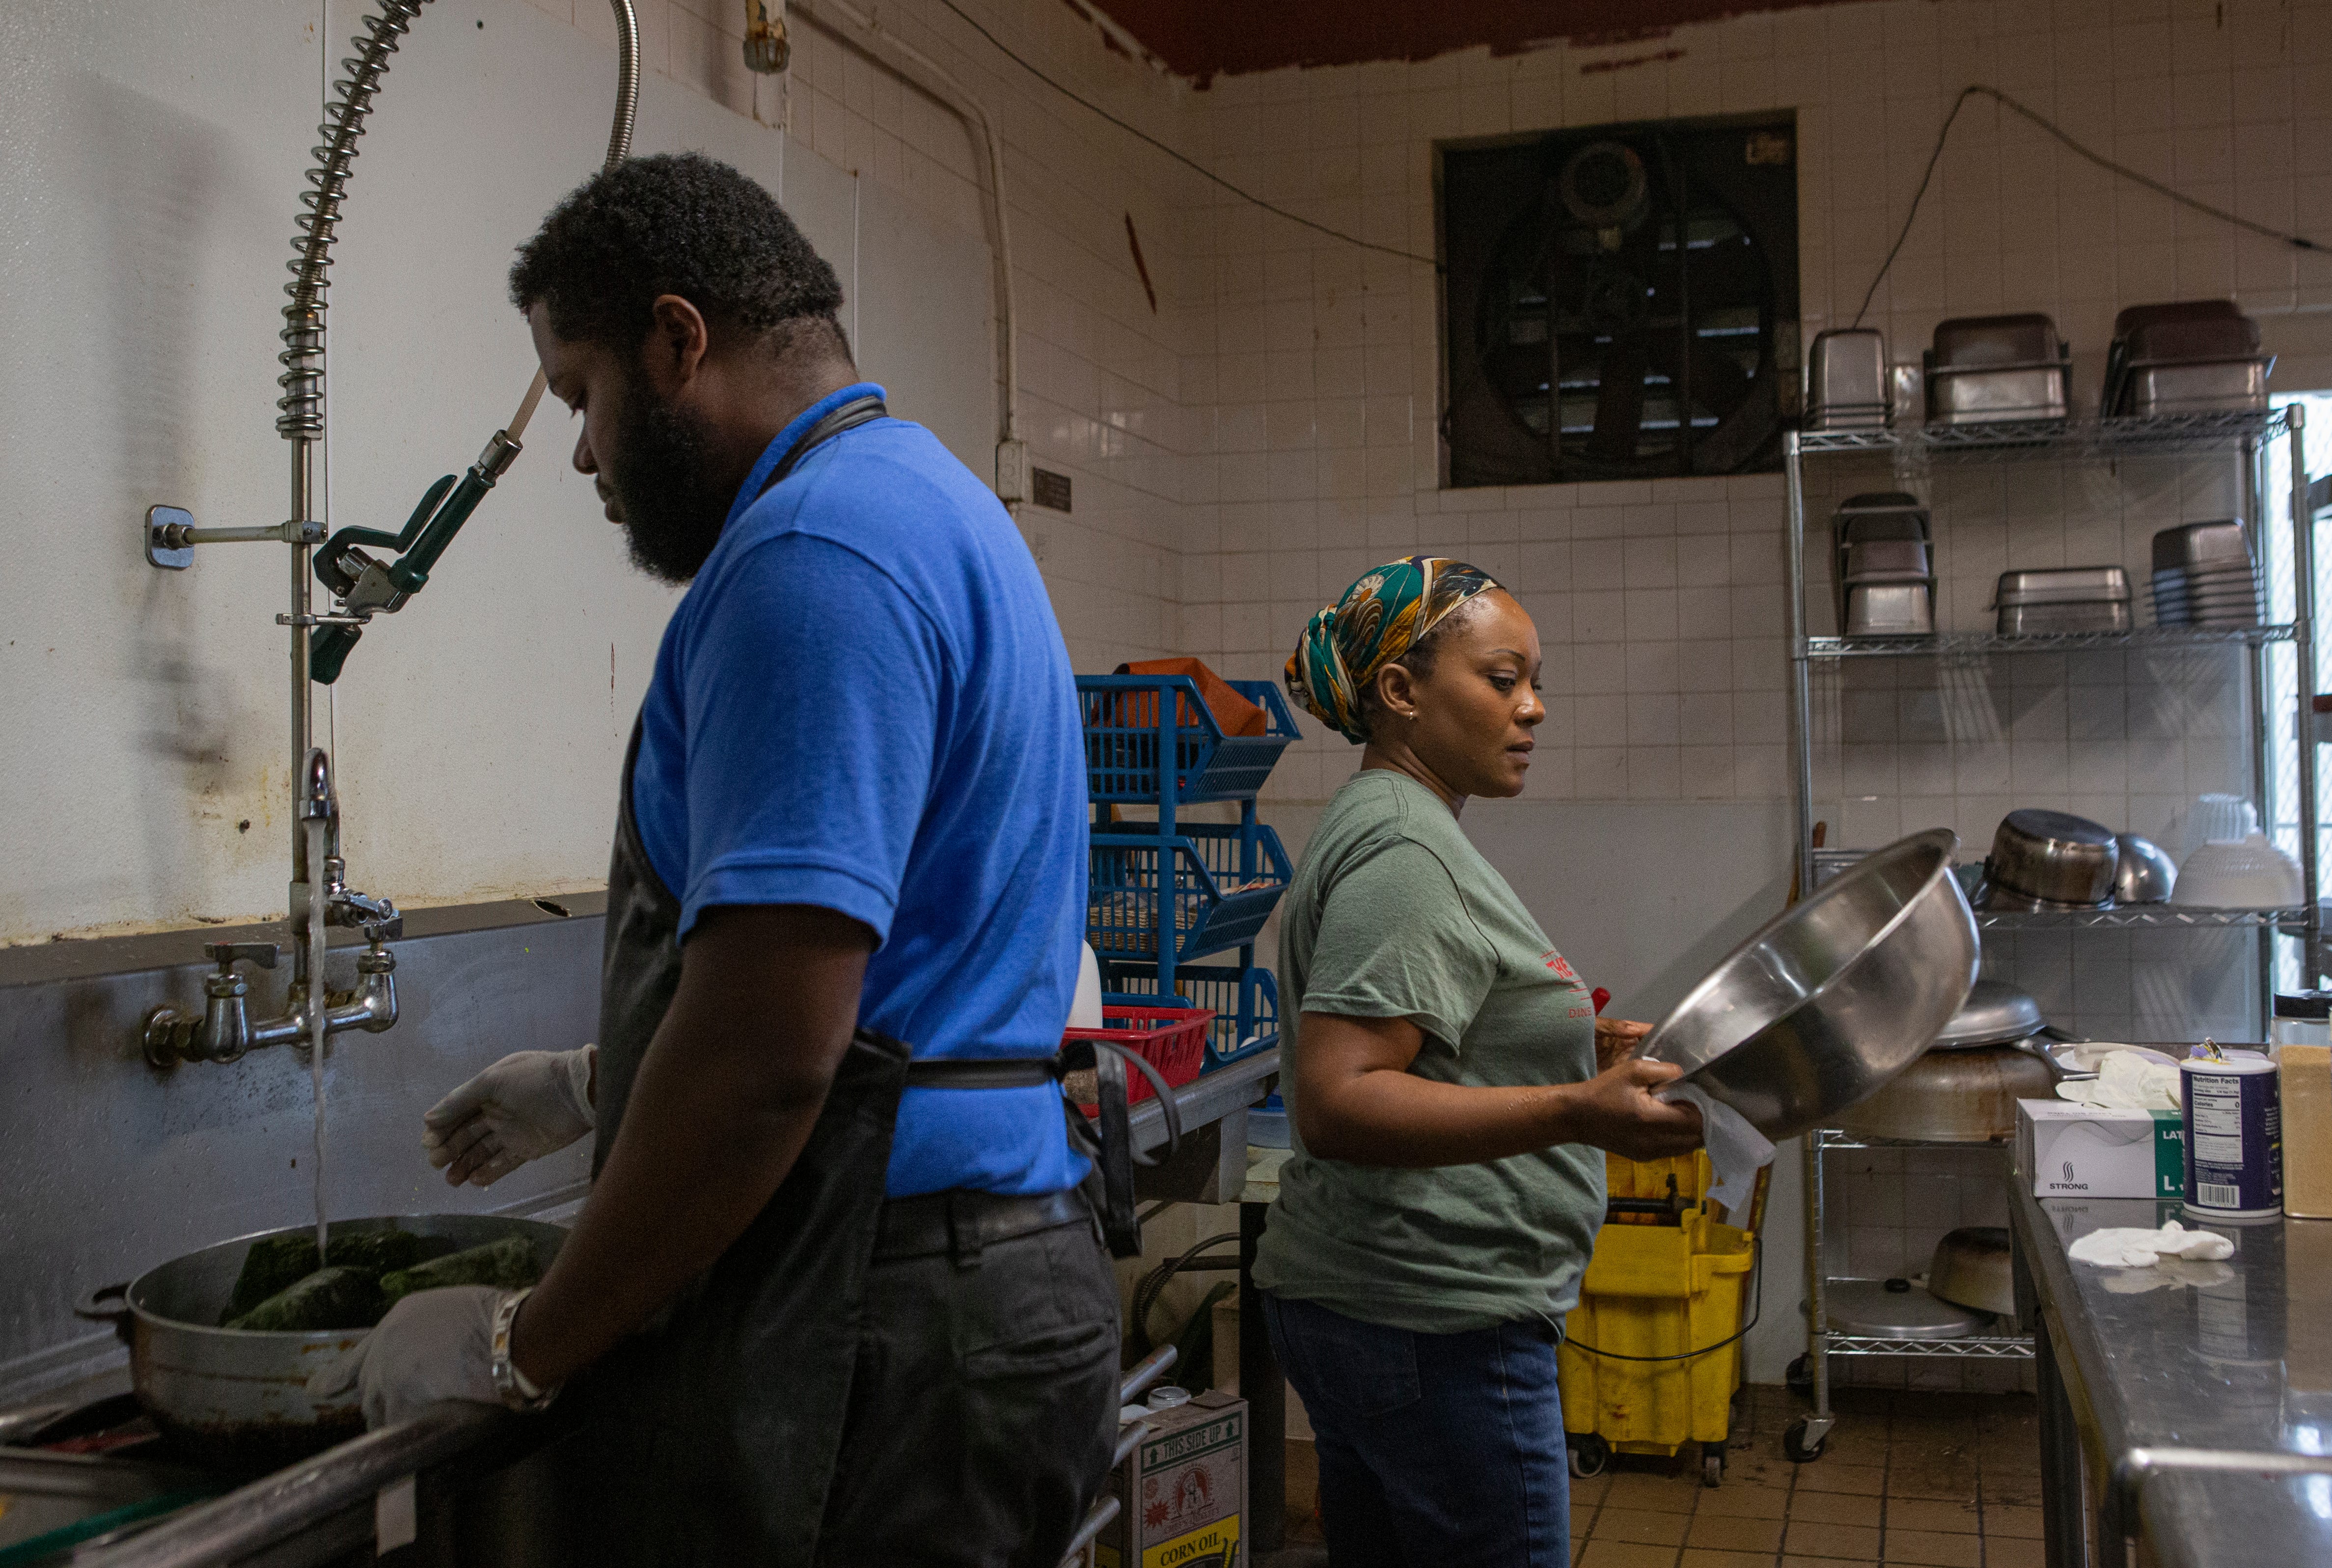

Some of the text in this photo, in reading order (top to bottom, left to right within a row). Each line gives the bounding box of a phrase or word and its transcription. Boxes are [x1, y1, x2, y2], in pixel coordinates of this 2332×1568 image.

[1164, 1425, 1221, 1458] THIS SIDE UP
[1160, 1532, 1220, 1566] CORN OIL
